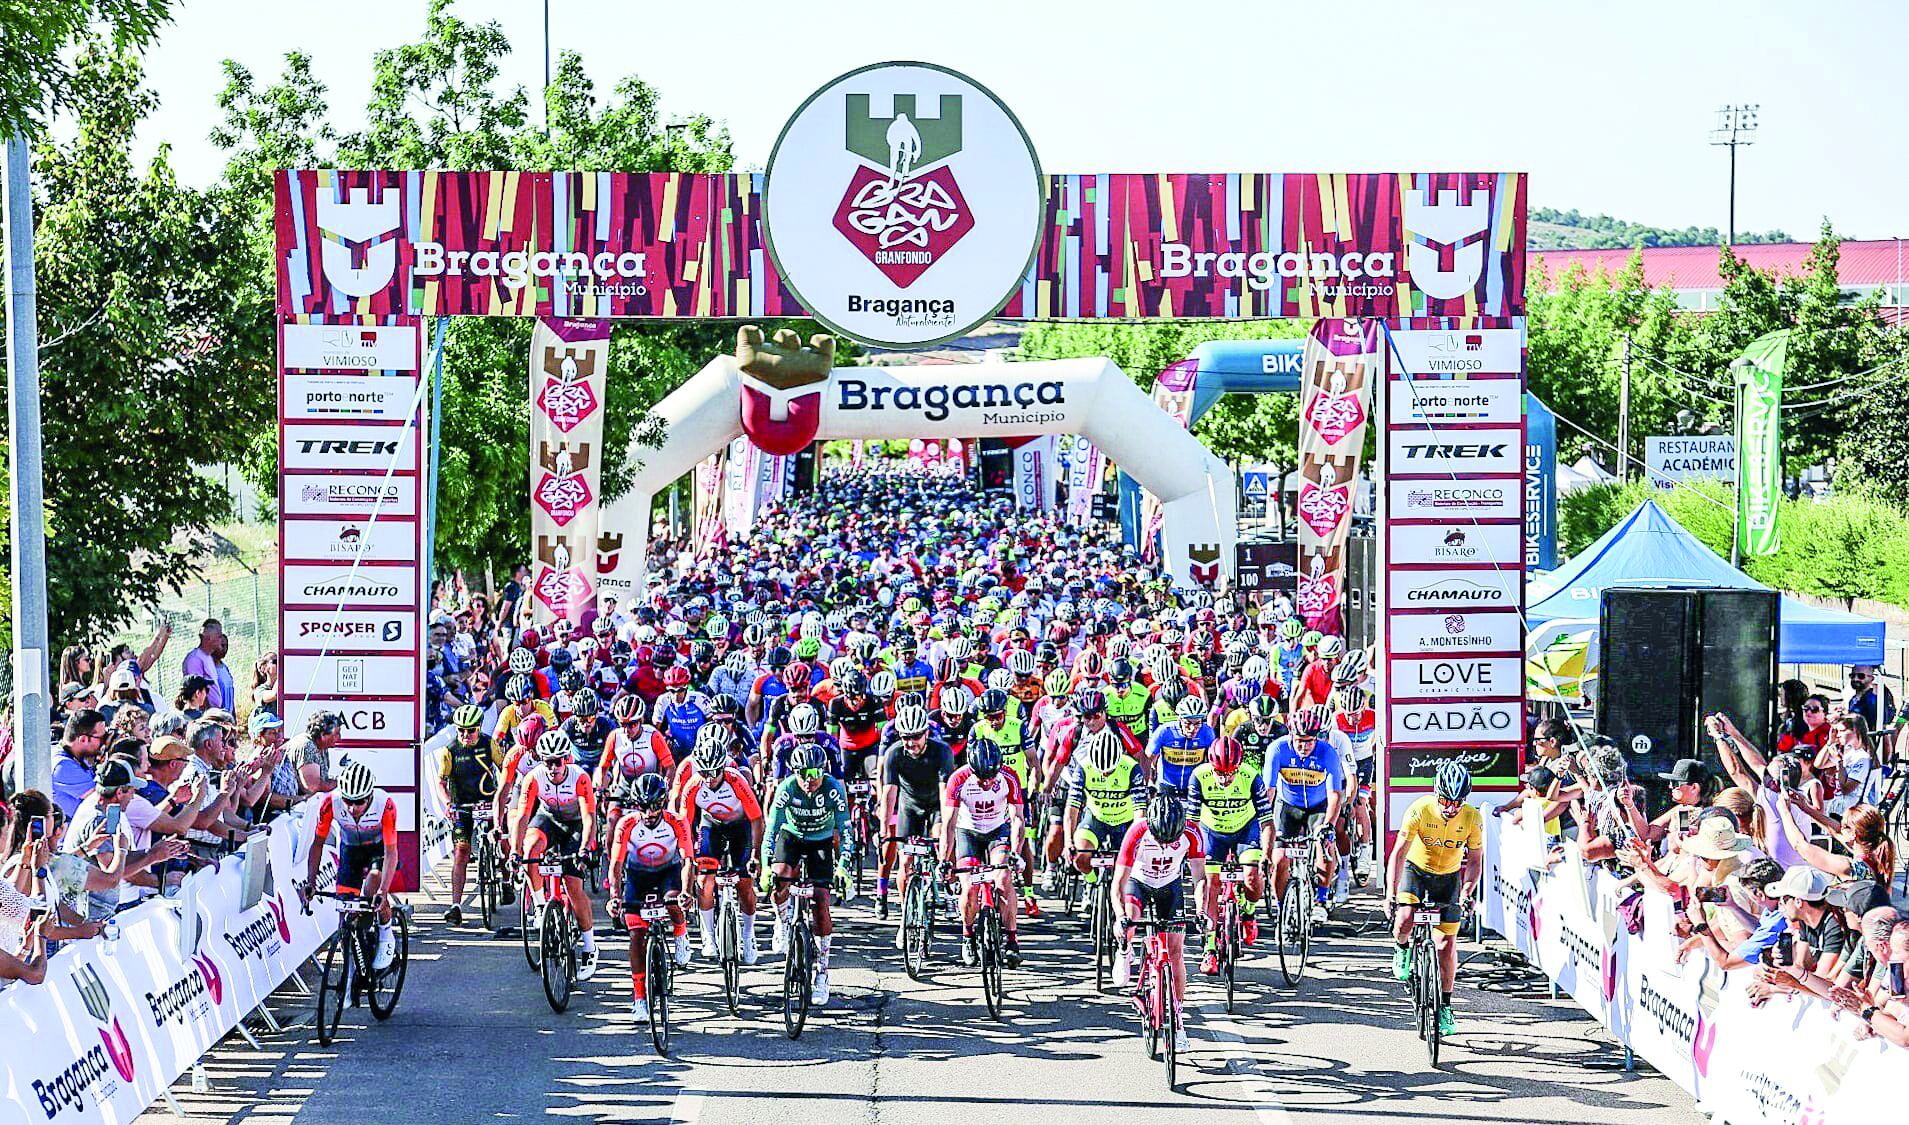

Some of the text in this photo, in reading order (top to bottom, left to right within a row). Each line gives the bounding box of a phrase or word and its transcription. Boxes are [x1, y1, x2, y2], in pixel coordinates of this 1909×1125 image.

[414, 242, 646, 288] Bragança
[875, 250, 932, 265] GRANFONDO
[1160, 243, 1394, 290] Bragança
[562, 281, 647, 297] Município
[1308, 282, 1394, 298] Município
[848, 295, 955, 318] Bragança
[323, 355, 377, 367] VIMIOSO
[1428, 359, 1482, 370] VIMIOSO
[838, 380, 1065, 421] Bragança
[983, 411, 1065, 425] Município
[296, 440, 399, 455] TREK
[1401, 444, 1508, 458] TREK
[1659, 441, 1734, 454] RESTAURAN
[1662, 456, 1734, 471] ACADÉMIC
[1434, 488, 1503, 500] RECONCO
[1245, 548, 1252, 561] 1
[1435, 547, 1476, 557] BISARO
[1240, 573, 1259, 587] 100
[303, 586, 398, 597] CHAMAUTO
[1407, 590, 1502, 601] CHAMAUTO
[299, 622, 375, 637] SPONSER
[1419, 663, 1492, 684] LOVE
[338, 711, 385, 730] ACB
[1403, 706, 1510, 731] CADÃO
[1456, 750, 1491, 763] doce
[829, 788, 845, 812] OMG
[223, 911, 277, 961] Bragança
[145, 969, 204, 1028] Bragança
[1640, 973, 1695, 1043] Bragança
[31, 1043, 109, 1121] Bragança
